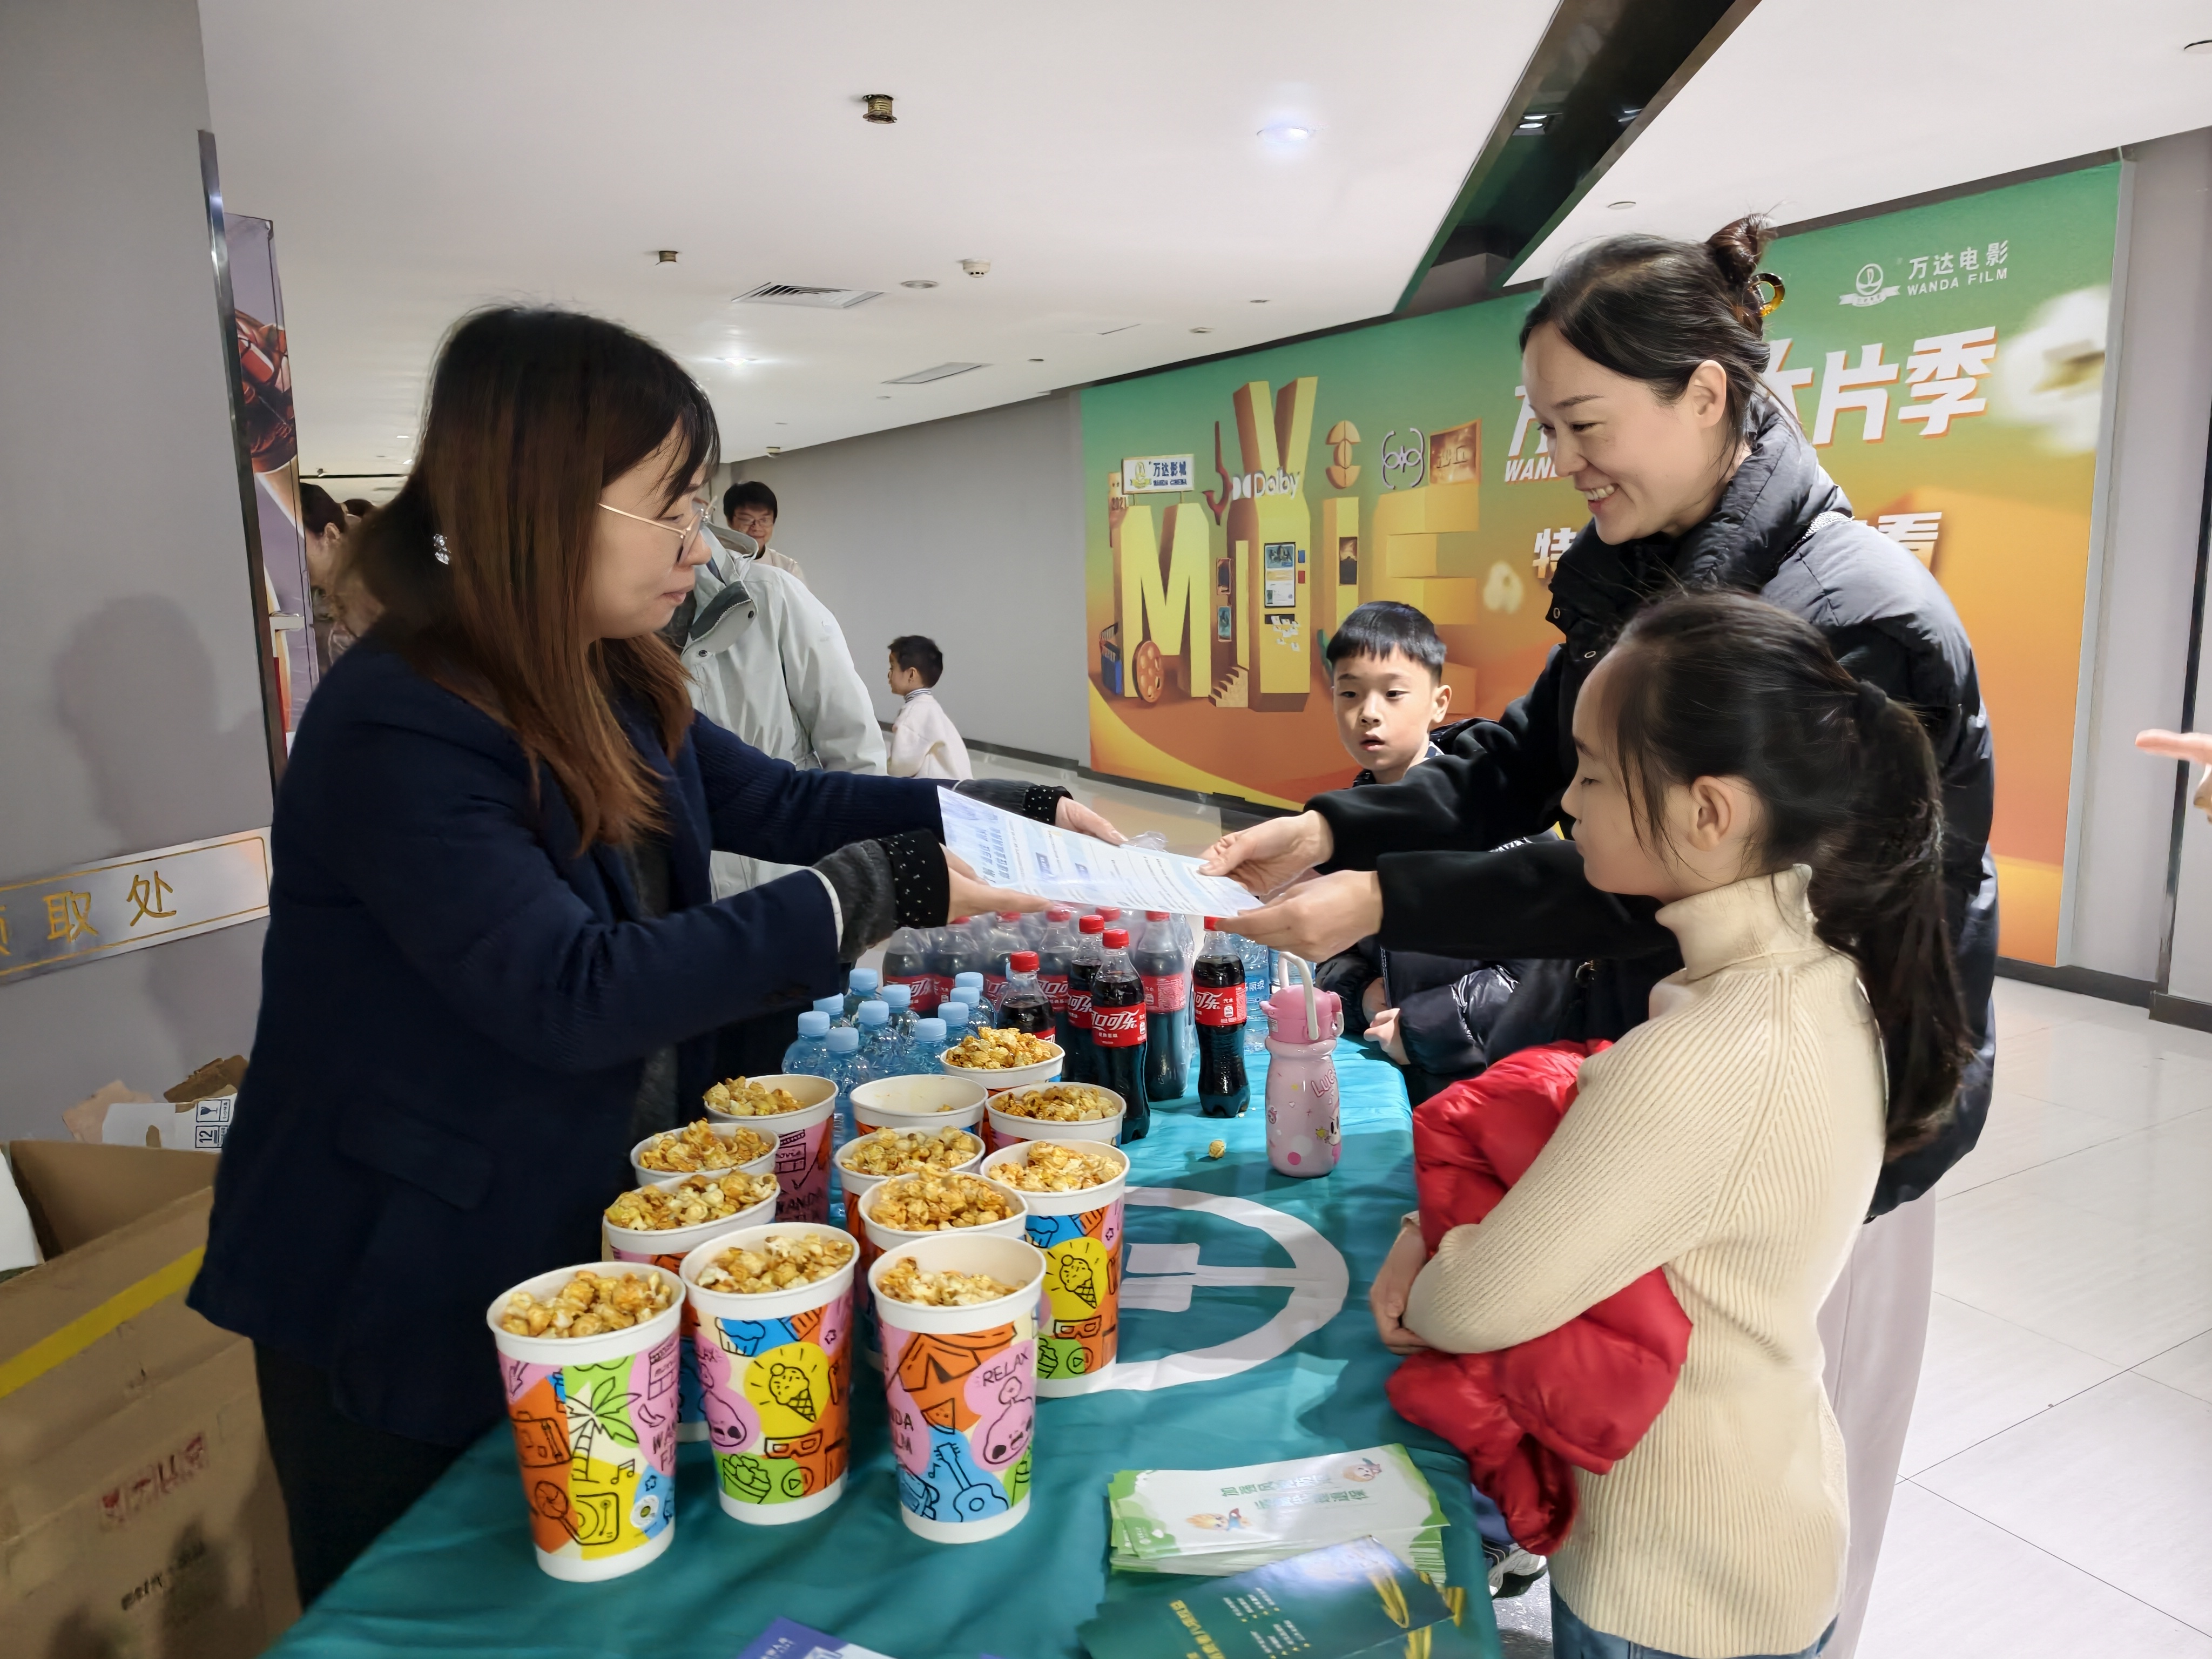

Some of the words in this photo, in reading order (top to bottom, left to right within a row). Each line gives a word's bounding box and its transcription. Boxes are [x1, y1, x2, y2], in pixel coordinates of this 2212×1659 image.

[1908, 240, 2008, 280] 万达电影
[1907, 277, 1959, 296] WANDA
[1968, 268, 2007, 285] FILM
[1254, 466, 1300, 500] Dolby
[199, 1130, 213, 1143] 12
